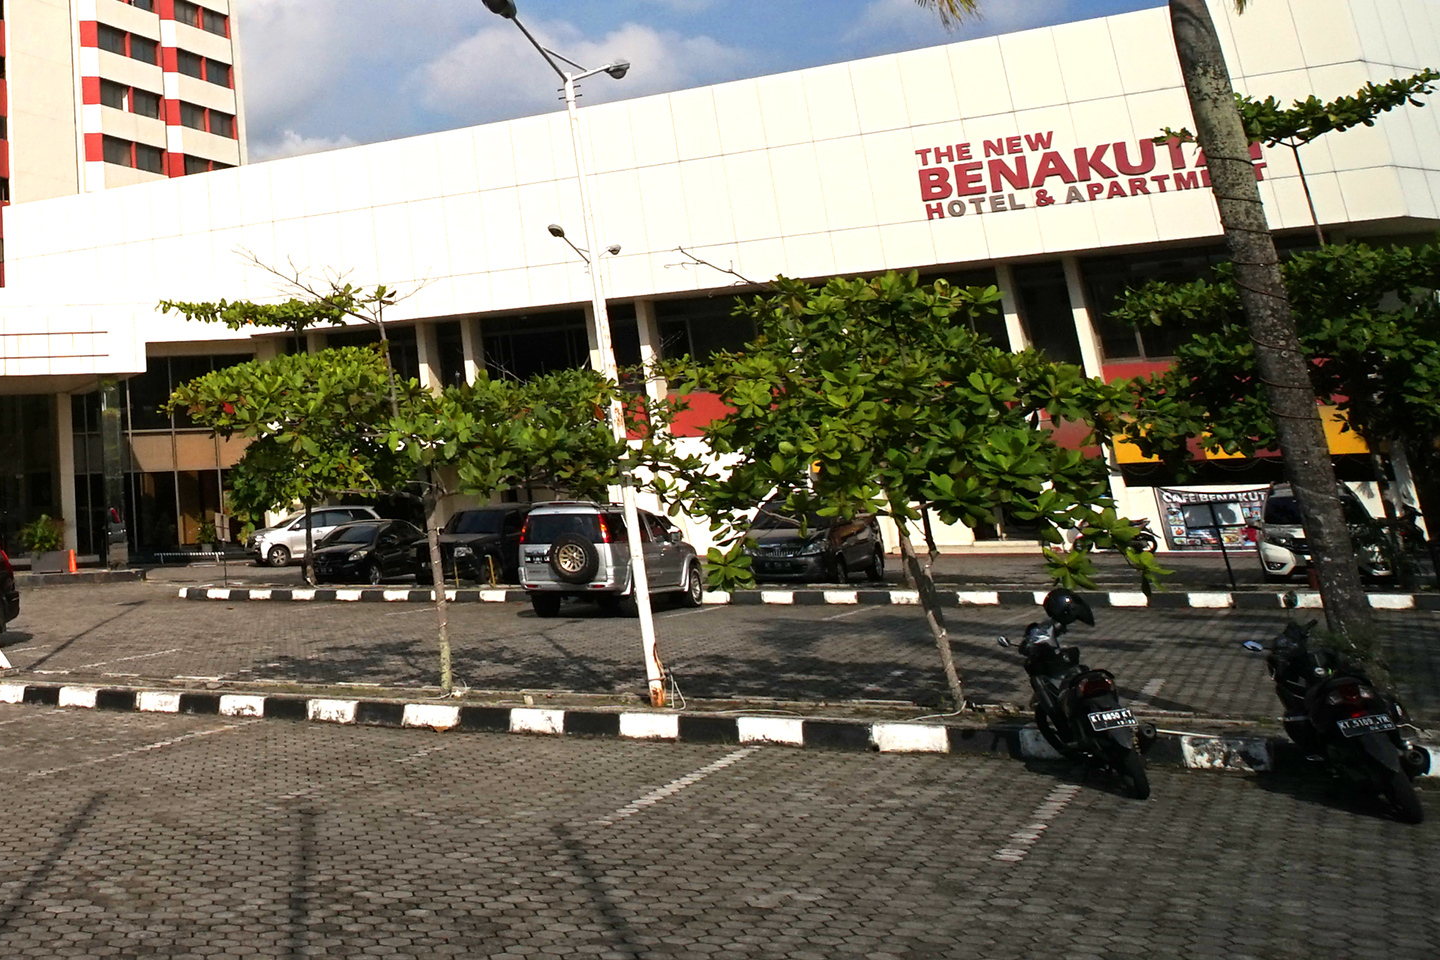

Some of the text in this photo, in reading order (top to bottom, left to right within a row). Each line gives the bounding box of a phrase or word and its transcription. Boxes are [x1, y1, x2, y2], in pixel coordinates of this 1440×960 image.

[915, 130, 1054, 167] THE NEW
[918, 131, 1263, 202] BENAKUT
[925, 162, 1268, 221] HOTEL & APARTMT
[1162, 491, 1196, 504] CAFE
[1090, 714, 1101, 723] KT
